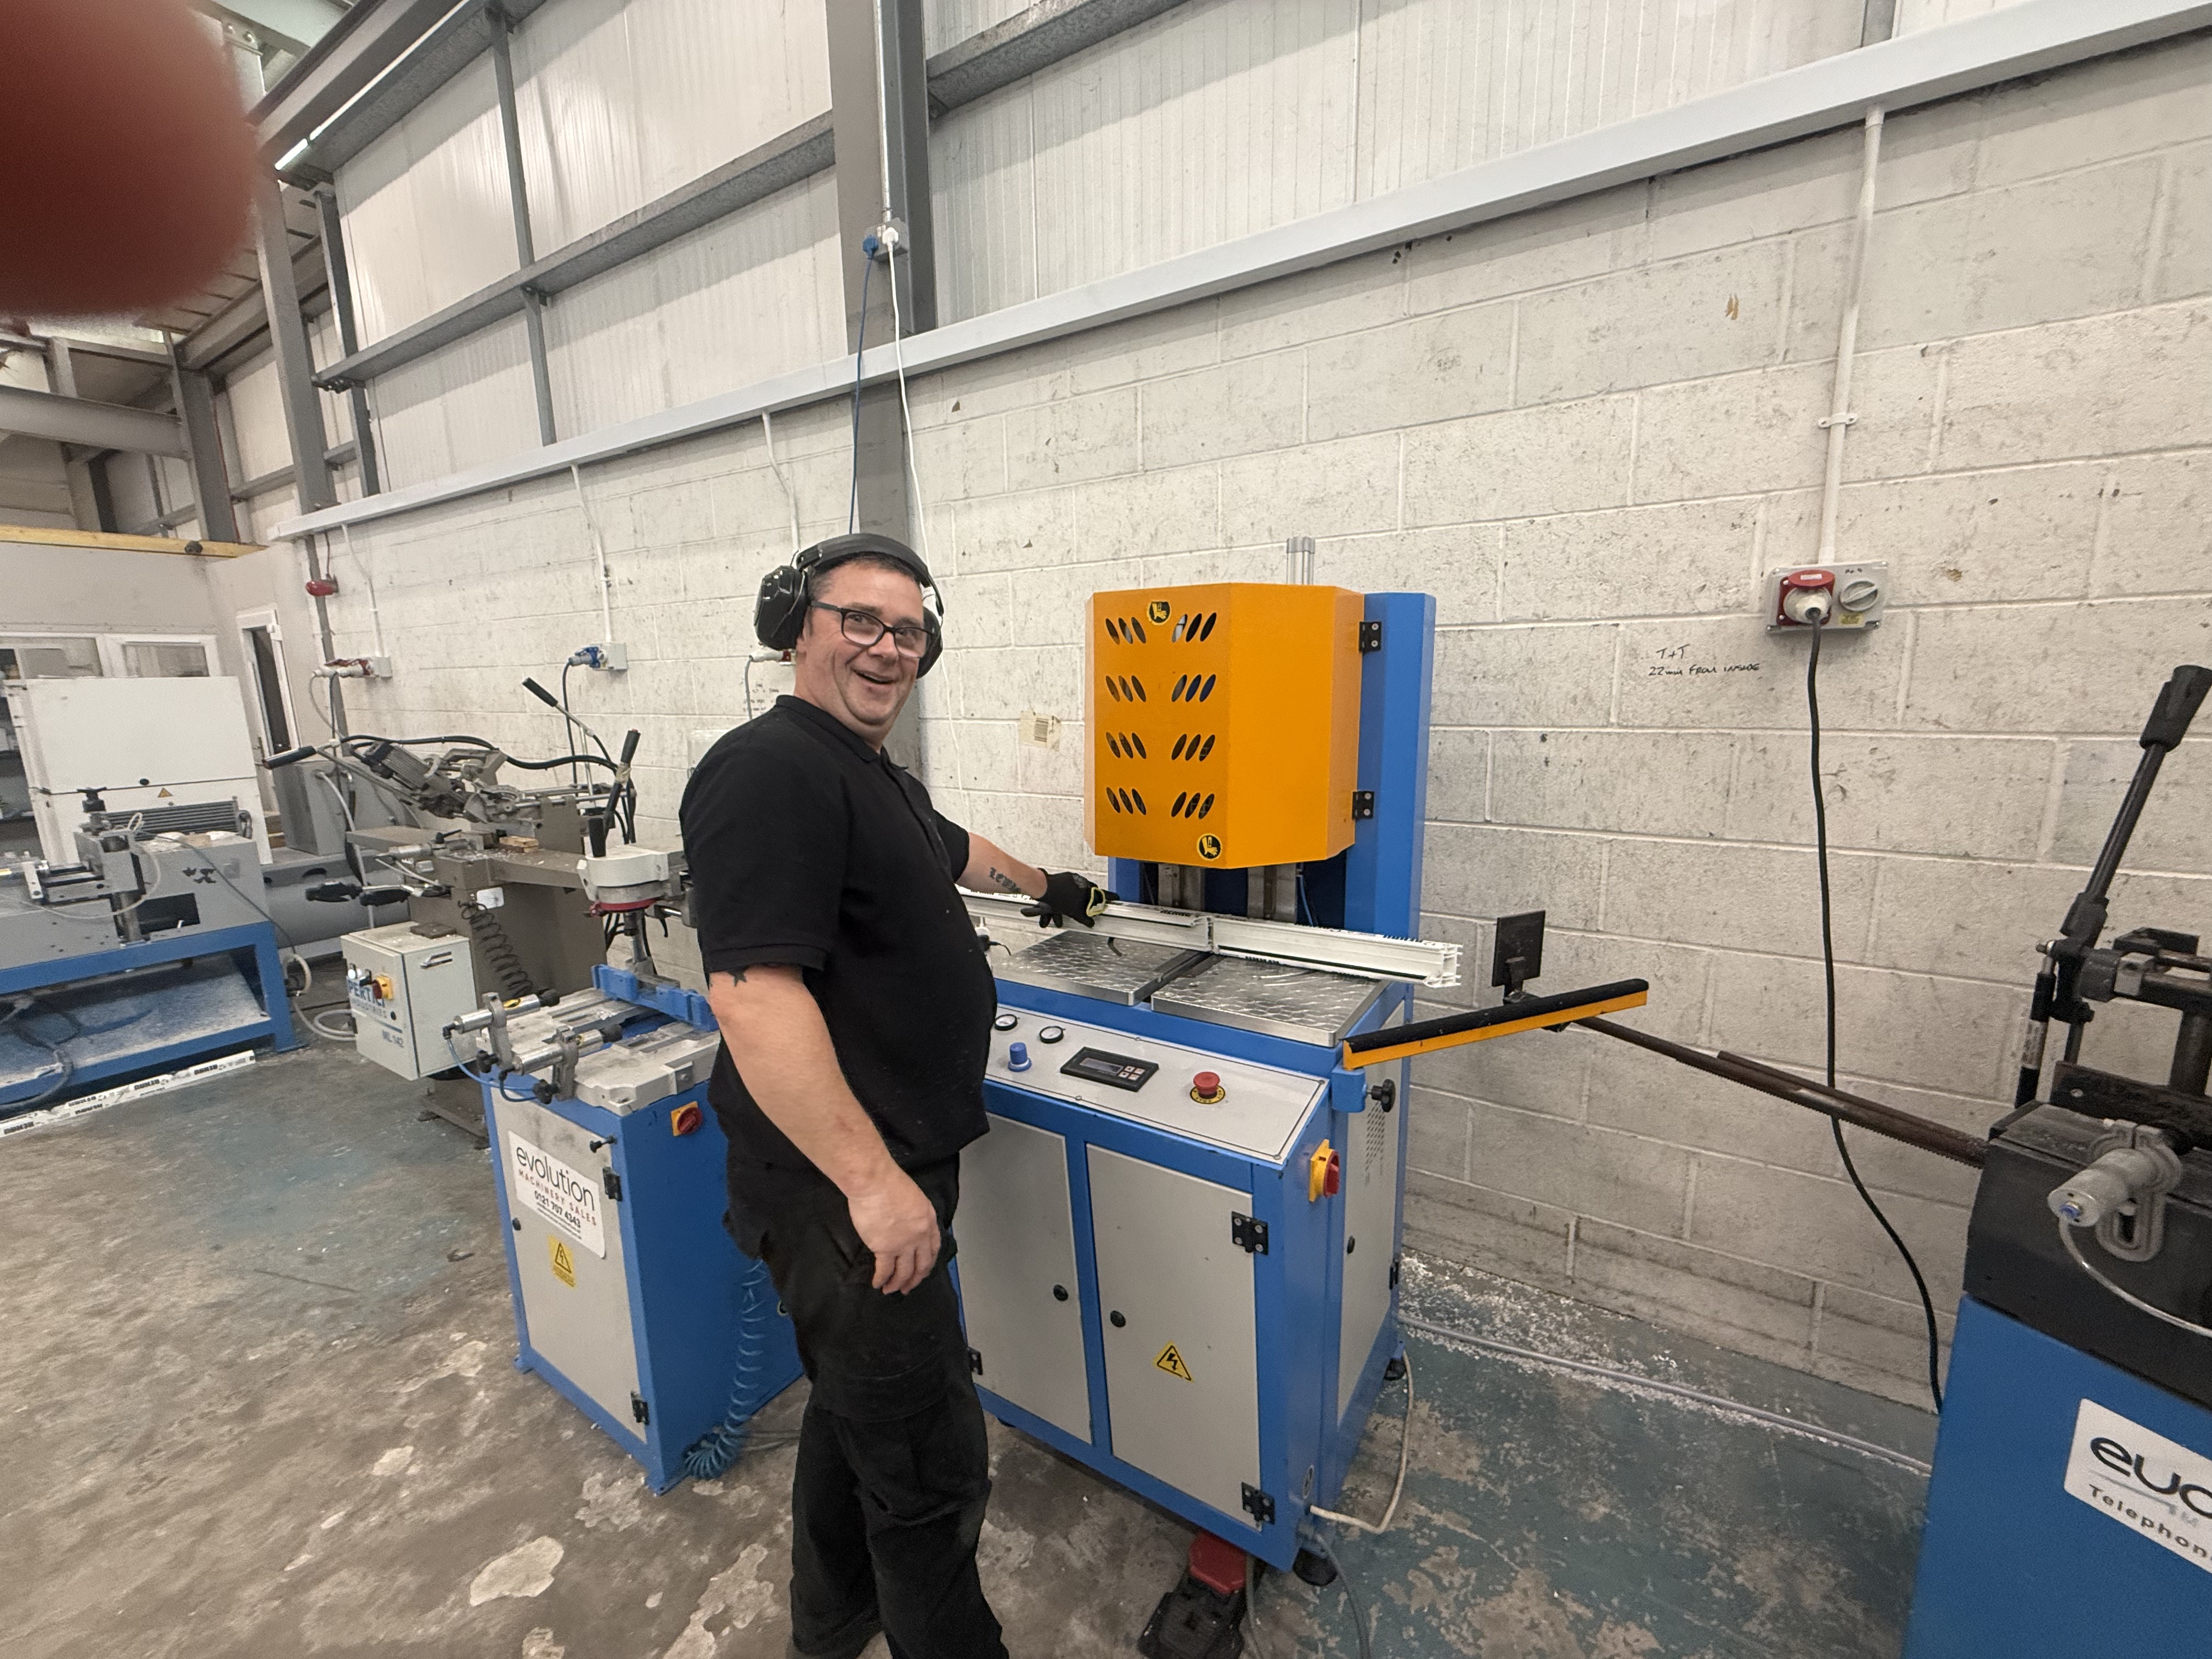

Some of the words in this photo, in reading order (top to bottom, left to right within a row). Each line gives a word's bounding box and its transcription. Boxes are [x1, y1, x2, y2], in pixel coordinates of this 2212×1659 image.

[516, 1147, 595, 1211] evolution
[518, 1169, 565, 1204] MACHINERY
[569, 1202, 596, 1226] SALES
[534, 1190, 550, 1207] 0121
[2089, 1483, 2212, 1562] Telephon
